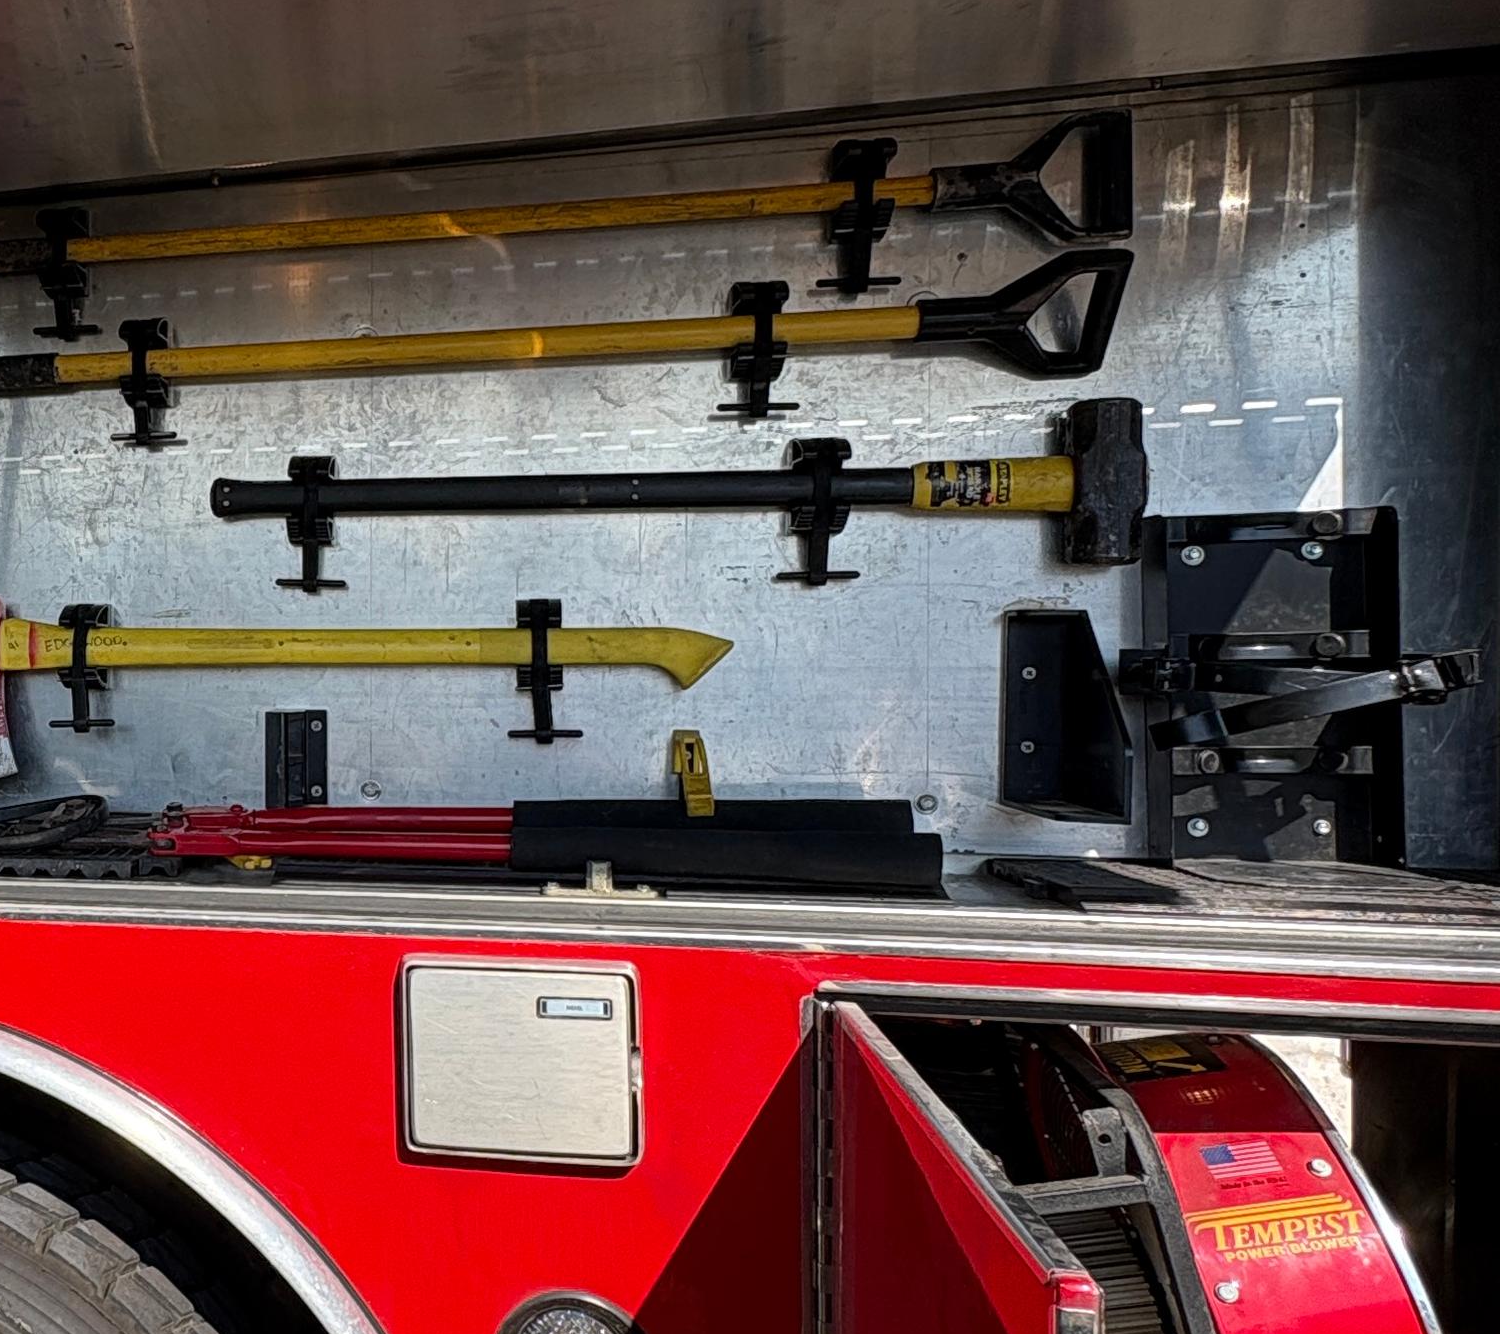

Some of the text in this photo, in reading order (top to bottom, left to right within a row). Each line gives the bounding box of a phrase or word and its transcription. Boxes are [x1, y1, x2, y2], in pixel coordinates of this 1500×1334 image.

[1194, 1204, 1366, 1252] TEMPEST
[1224, 1235, 1362, 1263] POWER BLOWER
